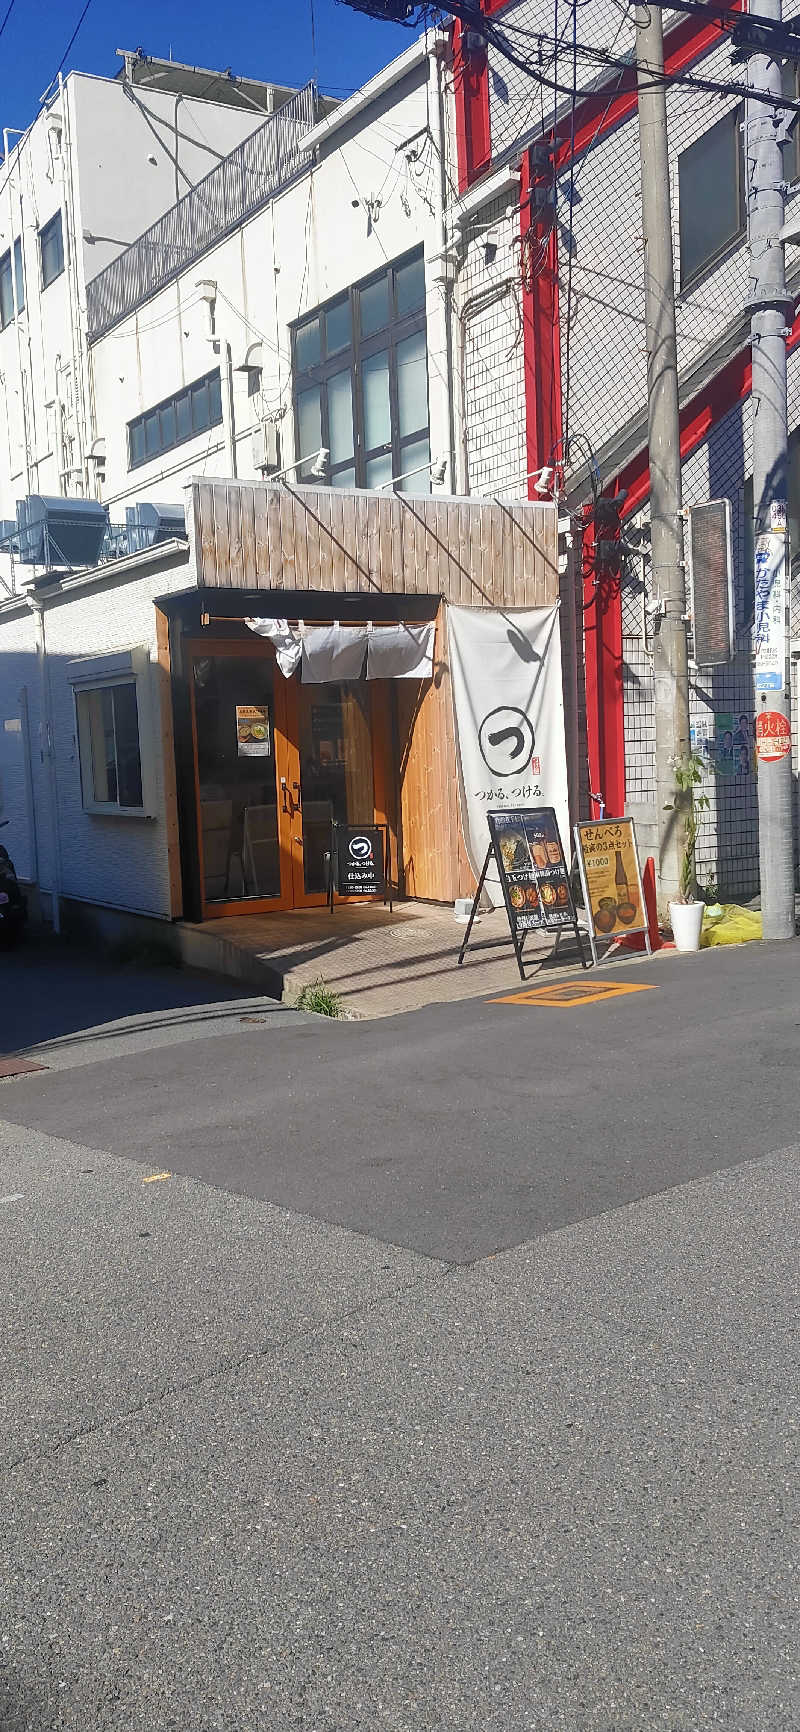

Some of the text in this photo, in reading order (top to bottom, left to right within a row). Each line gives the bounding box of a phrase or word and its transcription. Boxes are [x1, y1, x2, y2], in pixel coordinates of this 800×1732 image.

[755, 568, 771, 644] かたやま小児科
[488, 726, 525, 760] つ
[474, 784, 545, 801] つかる、つける。
[584, 825, 623, 841] せんべろ
[352, 842, 369, 854] つ
[347, 872, 375, 881] 仕込み中
